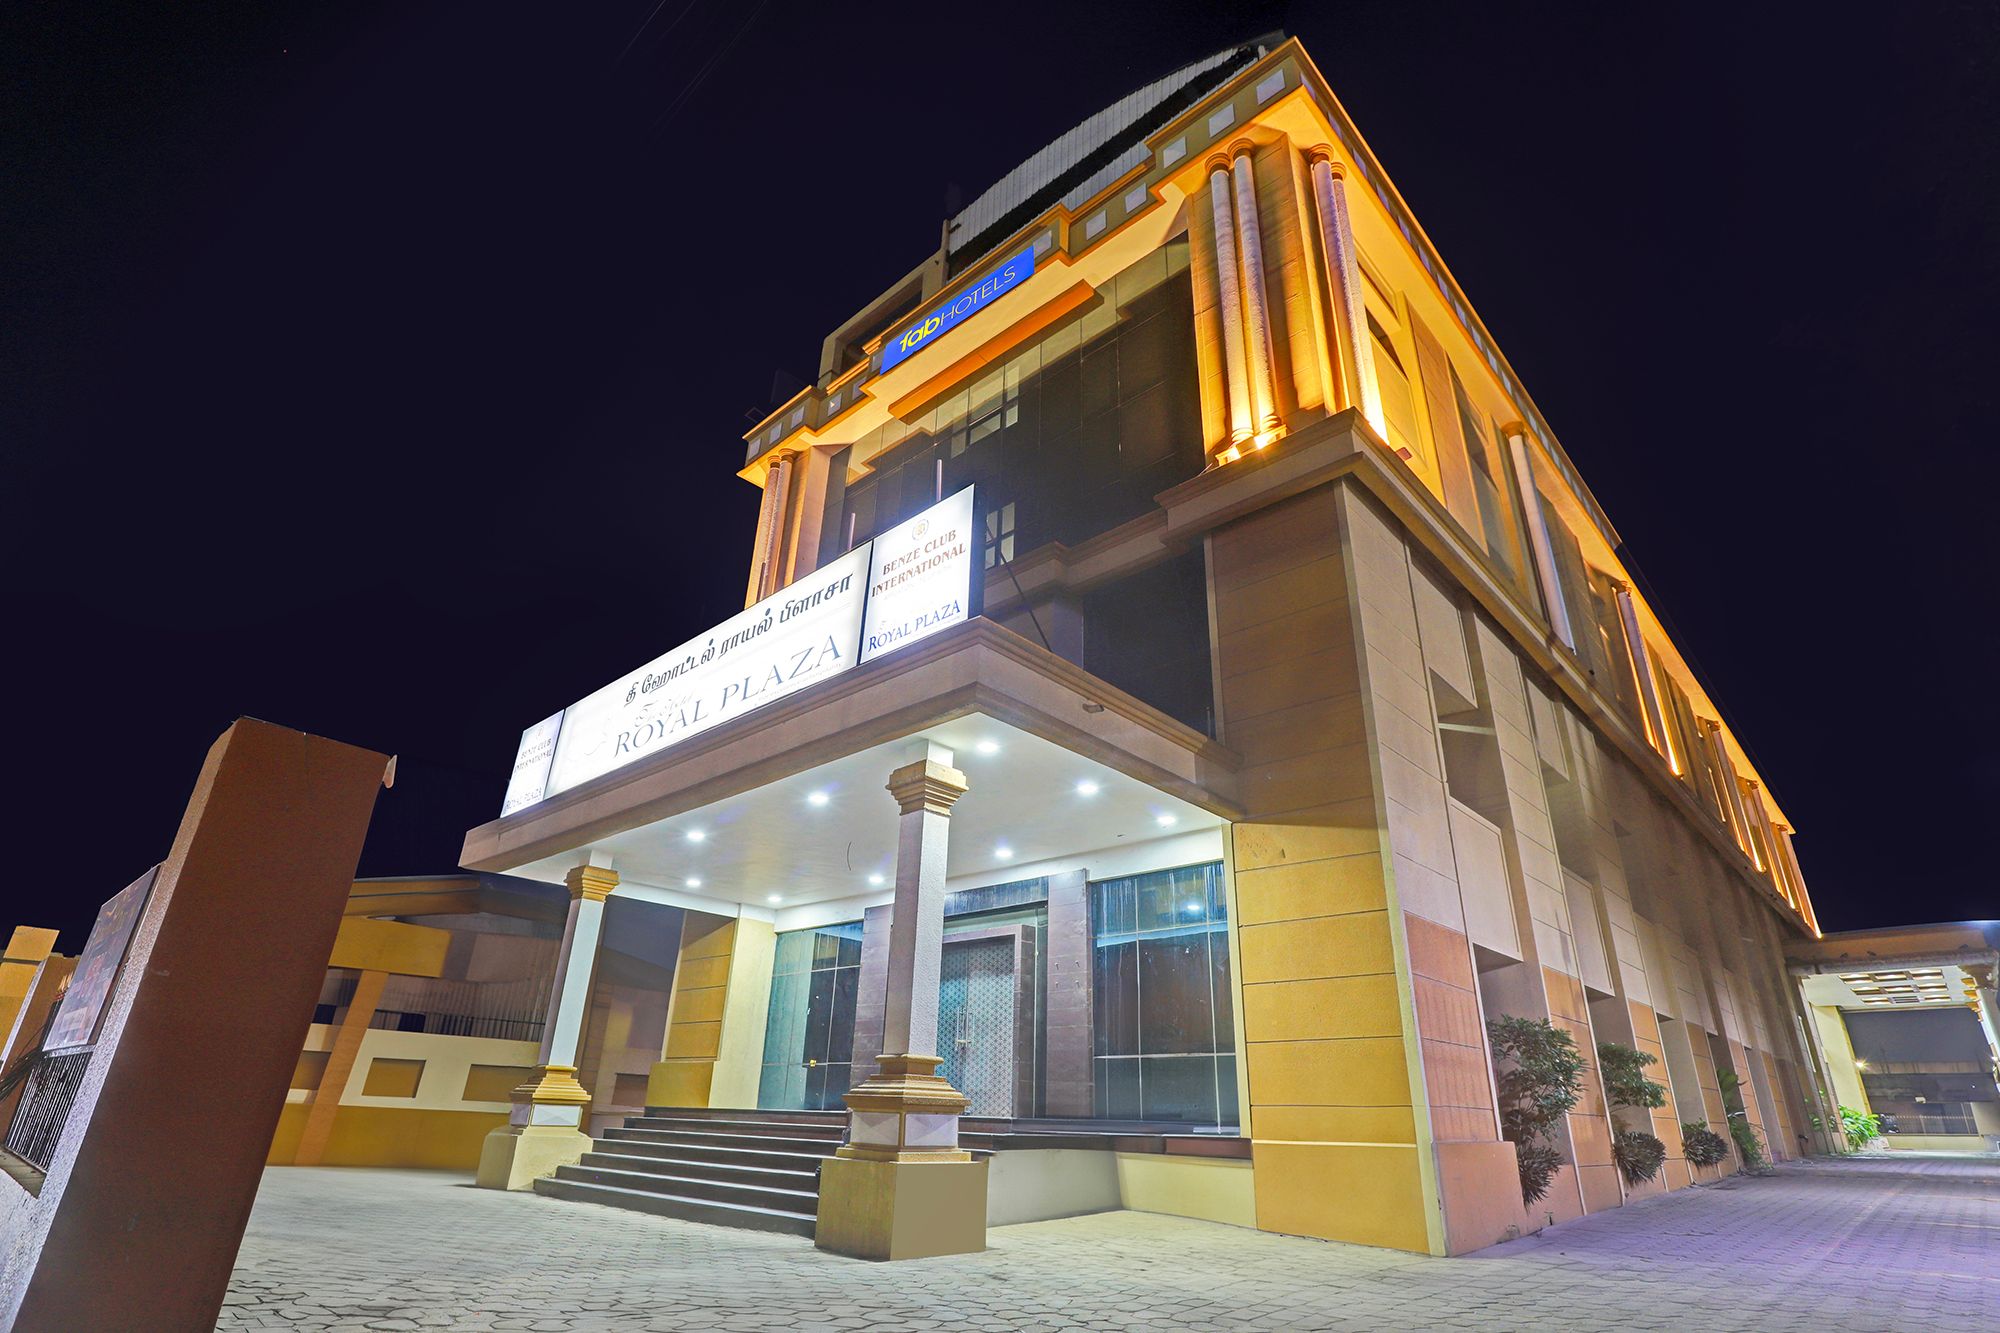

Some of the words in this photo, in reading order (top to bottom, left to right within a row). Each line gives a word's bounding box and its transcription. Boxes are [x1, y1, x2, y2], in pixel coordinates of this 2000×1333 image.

[871, 543, 966, 598] INTERNATIONAL
[883, 548, 920, 575] BENZE
[924, 529, 957, 554] CLUB
[717, 607, 774, 660] ராயல்
[867, 622, 912, 653] ROYAL
[914, 599, 961, 632] PLAZA
[614, 699, 710, 760] ROYAL
[719, 634, 842, 712] PLAZA
